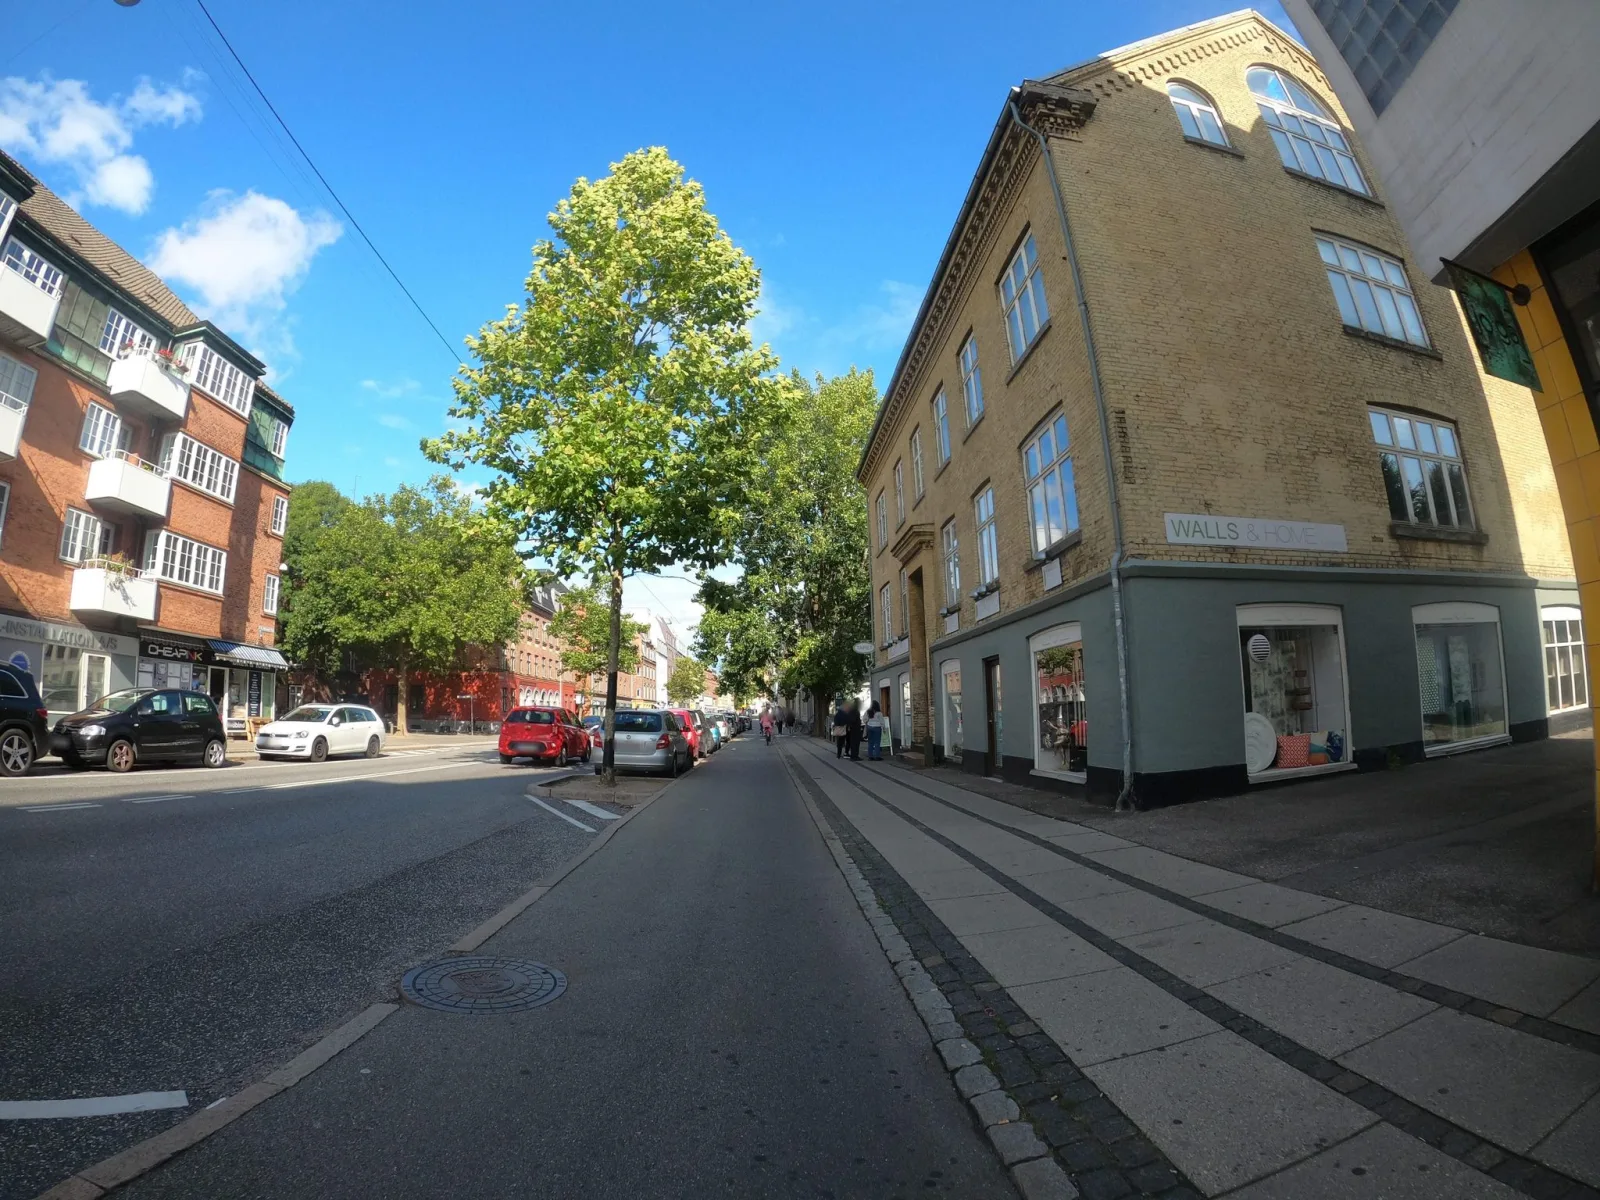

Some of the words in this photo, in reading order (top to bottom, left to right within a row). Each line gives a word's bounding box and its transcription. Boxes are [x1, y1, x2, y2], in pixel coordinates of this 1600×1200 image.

[1171, 519, 1240, 540] WALLS
[1246, 523, 1260, 542] &
[1264, 524, 1318, 545] HOME
[0, 619, 95, 649] -INSTALLATION
